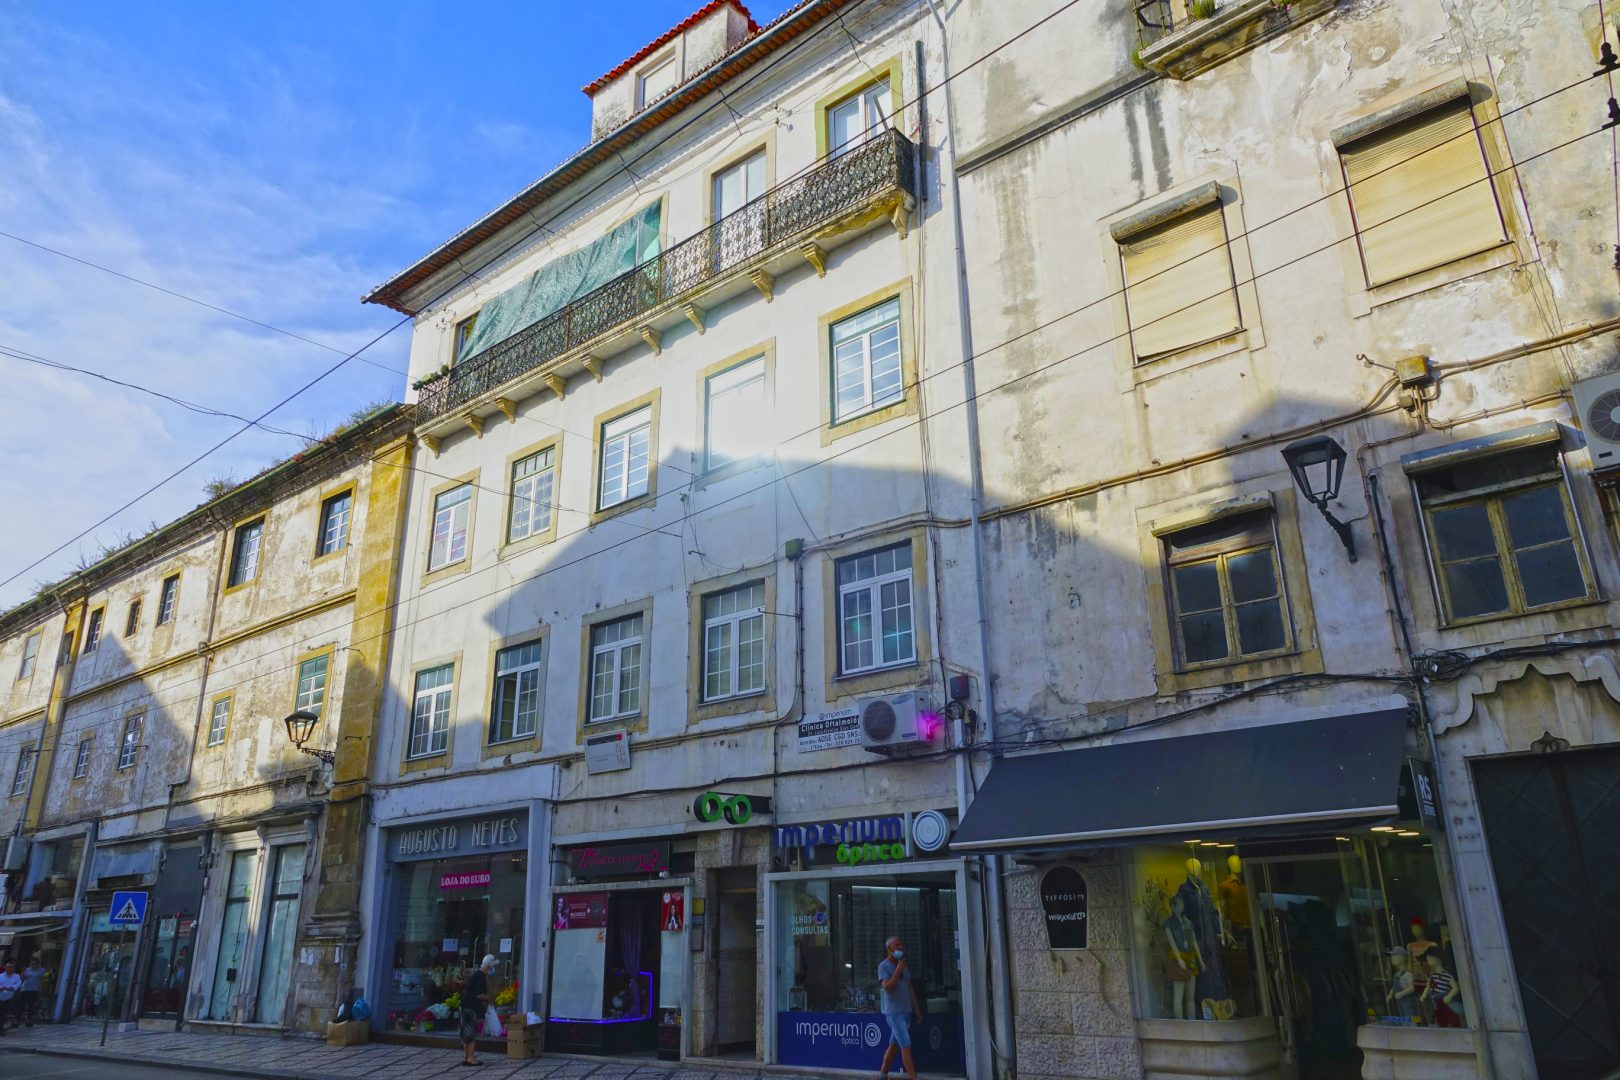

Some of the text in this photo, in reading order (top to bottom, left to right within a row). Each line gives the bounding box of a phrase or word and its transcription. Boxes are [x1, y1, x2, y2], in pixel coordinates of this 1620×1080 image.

[833, 732, 846, 741] CGD
[1417, 774, 1432, 800] RS
[399, 817, 518, 855] AUGUSTO NEVES
[774, 816, 904, 860] imperium
[836, 841, 906, 866] óptica
[441, 873, 491, 886] LOJA DO EURO
[1045, 893, 1077, 902] TIFFOSI
[791, 925, 829, 936] CONSULTAS
[796, 1021, 859, 1045] imperium
